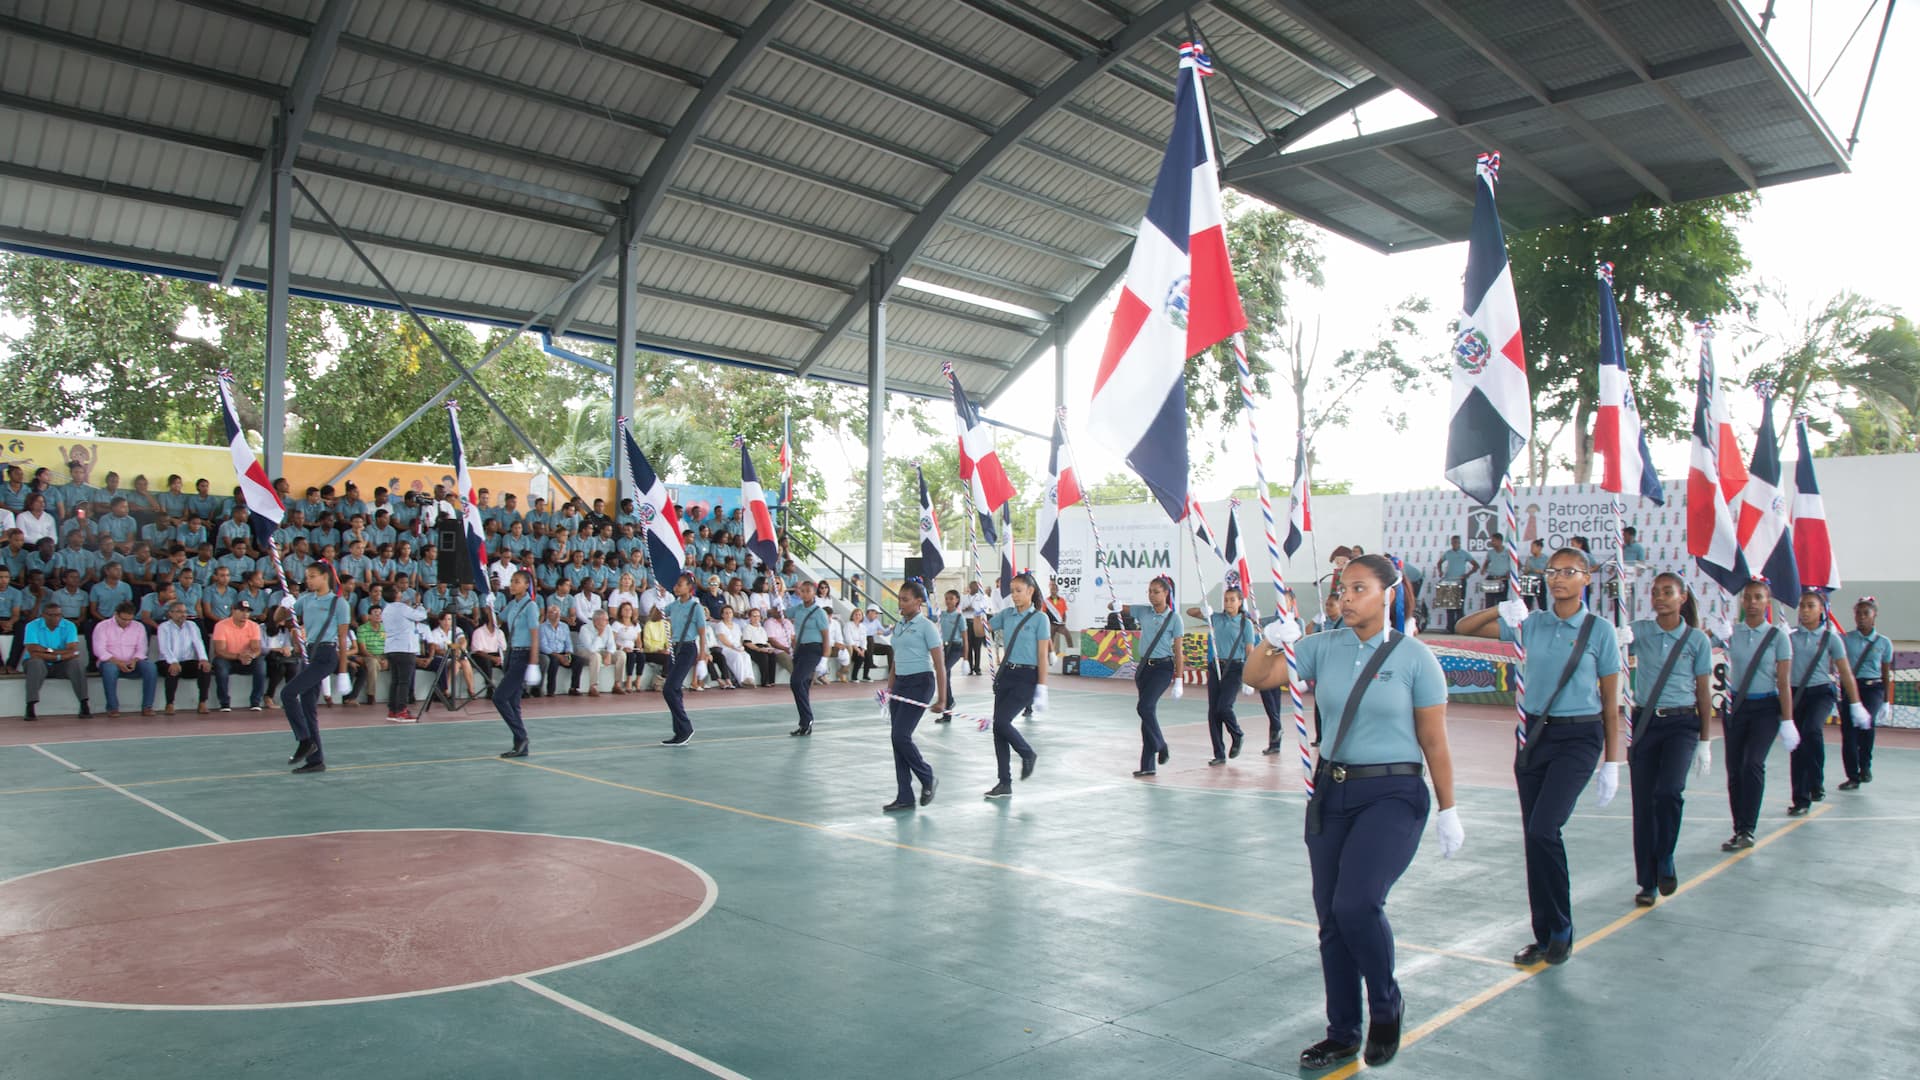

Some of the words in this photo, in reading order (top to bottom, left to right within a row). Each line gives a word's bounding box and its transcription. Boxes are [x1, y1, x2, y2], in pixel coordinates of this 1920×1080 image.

[1549, 502, 1627, 515] Patronato
[1549, 534, 1618, 550] Ornta
[1096, 550, 1170, 568] PANAM
[1050, 575, 1082, 588] Hogar
